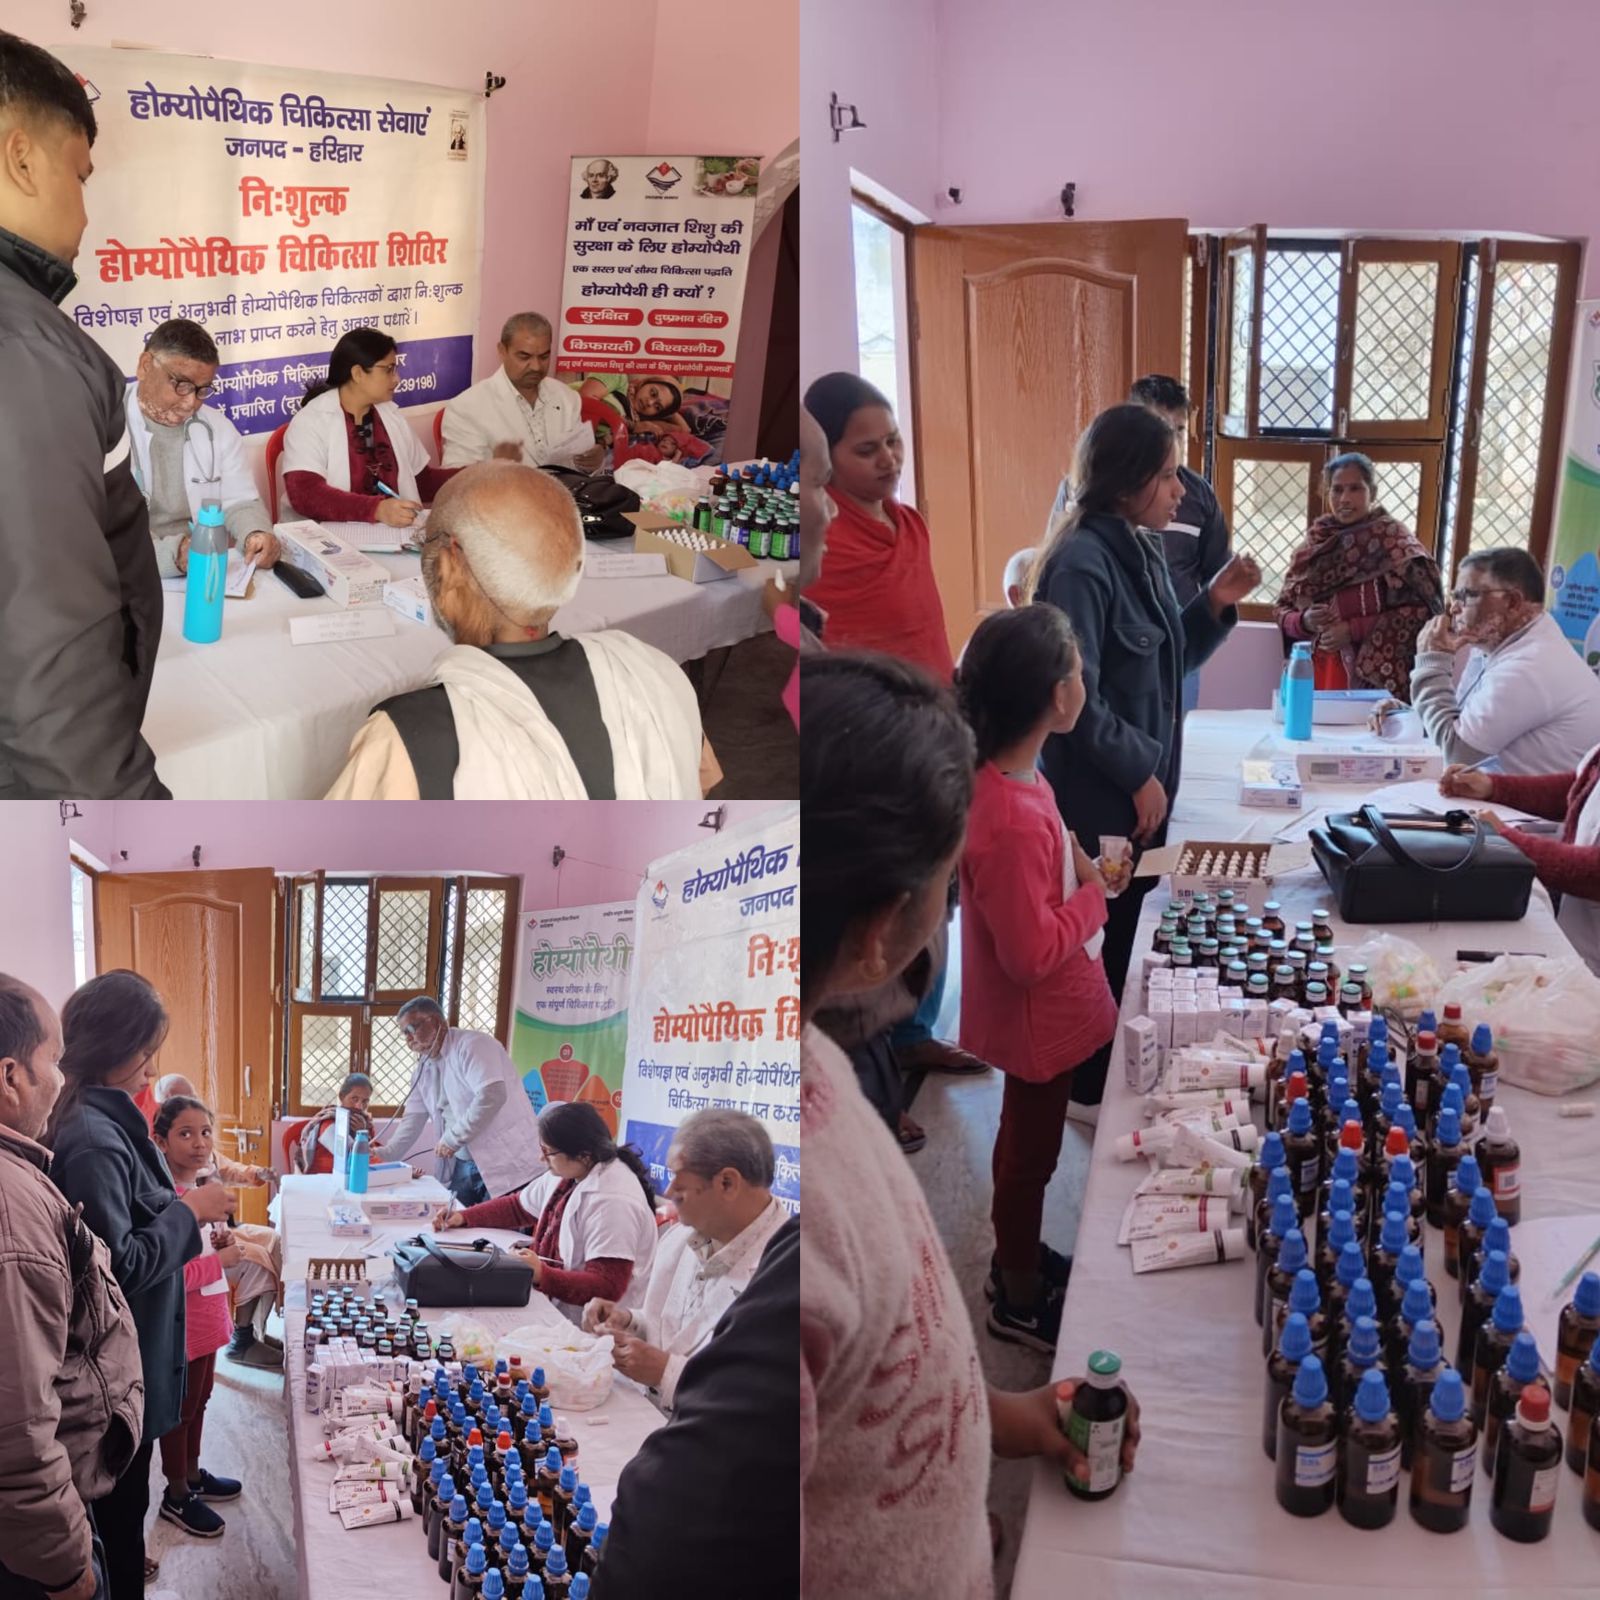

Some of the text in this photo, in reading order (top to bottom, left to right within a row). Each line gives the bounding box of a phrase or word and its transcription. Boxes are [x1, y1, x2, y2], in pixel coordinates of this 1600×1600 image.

[128, 81, 432, 135] होम्योपैथिक चिकित्सा सेवाएं
[225, 137, 287, 158] जनपद
[310, 135, 364, 163] हरिद्वार
[575, 217, 744, 239] माँ एवं नवजात शिशु की
[96, 231, 448, 282] होम्योपैथिक चिकित्सा शिविर
[573, 238, 741, 256] सुरक्षा के लिए होम्योपैथी
[572, 265, 588, 273] एक
[617, 264, 633, 274] एवं
[660, 264, 701, 276] चिकित्सा
[703, 266, 732, 277] पद्धति
[581, 282, 715, 299] होम्योपैथी ही क्यों ?
[74, 303, 143, 328] विशेषज्ञ
[148, 300, 173, 325] एवं
[178, 294, 236, 324] अनुभवी
[241, 289, 318, 317] होम्योपैथिक
[321, 284, 385, 307] चिकित्सकों
[580, 308, 630, 323] सुरक्षित
[215, 327, 245, 345] लाभ
[250, 324, 282, 342] प्राप्त
[286, 317, 316, 339] करने
[320, 316, 338, 339] हेतु
[342, 316, 380, 331] अवश्य
[384, 307, 413, 326] पधारें
[697, 314, 723, 325] रहित
[570, 338, 634, 353] किफायती
[651, 342, 718, 354] विश्वसनीय
[231, 396, 276, 420] प्रचारित
[682, 845, 793, 903] होम्योपैथिक
[739, 885, 797, 916] जनपद
[653, 1000, 766, 1043] होम्योपैथिक
[638, 1059, 672, 1082] विशेषज्ञ
[675, 1062, 691, 1083] एवं
[692, 1061, 733, 1088] अनुभवी
